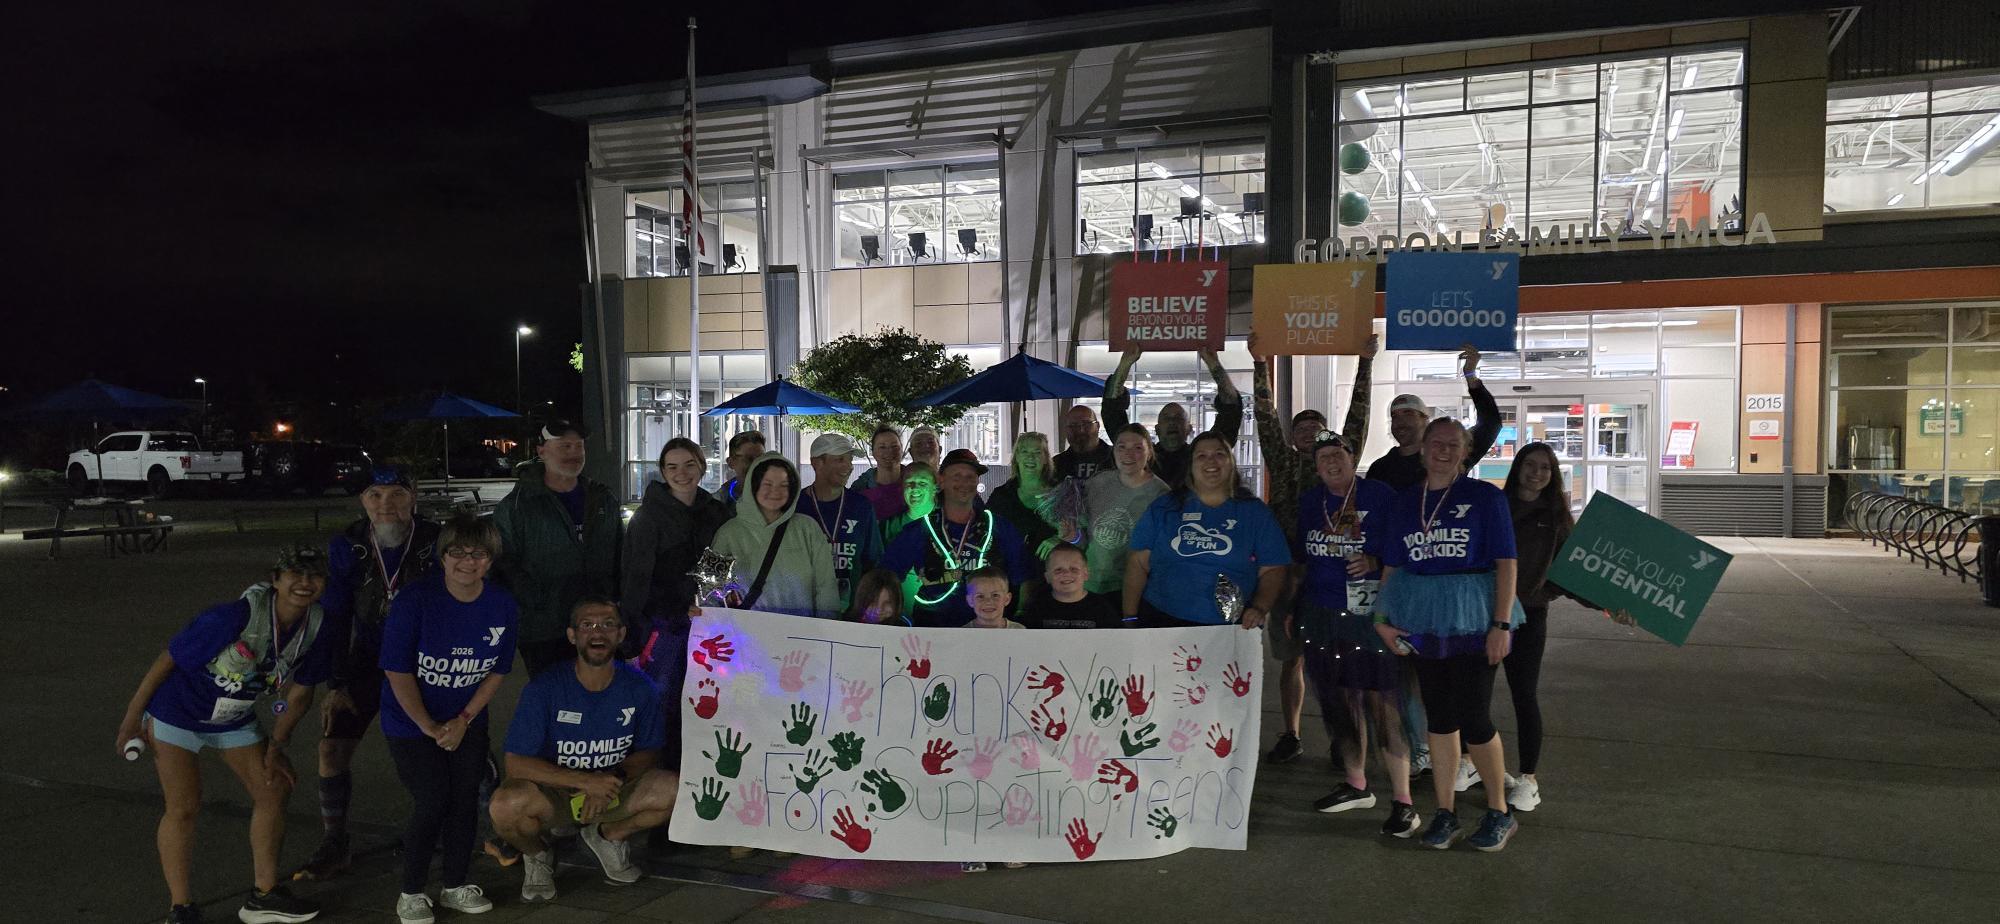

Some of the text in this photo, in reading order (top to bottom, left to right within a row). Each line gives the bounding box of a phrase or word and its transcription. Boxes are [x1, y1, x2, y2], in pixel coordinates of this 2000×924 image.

[1479, 219, 1628, 256] FAMILY
[1644, 212, 1777, 249] YMCA
[1127, 296, 1208, 313] BELIEVE
[1287, 294, 1338, 311] THIS IS
[1431, 290, 1473, 308] LET'S
[1129, 313, 1207, 326] BEYOND YOUR
[1284, 311, 1339, 329] YOUR
[1397, 309, 1506, 328] GOOOOOO
[1126, 325, 1208, 341] MEASURE
[1286, 329, 1336, 345] PLACE
[1747, 397, 1782, 409] 2015
[1425, 528, 1470, 544] MILES
[1196, 541, 1217, 550] FUN
[1433, 543, 1468, 558] KIDS
[1591, 536, 1686, 593] LIVE YOUR
[1568, 546, 1686, 619] POTENTIAL
[450, 647, 474, 656] 2026
[417, 651, 499, 674] 100 MILES
[417, 666, 452, 688] FOR
[787, 636, 1155, 761] Thank You
[556, 733, 635, 755] 100 MILES
[556, 749, 629, 770] FOR KIDS
[765, 752, 847, 835] For
[1104, 757, 1245, 839] Teens
